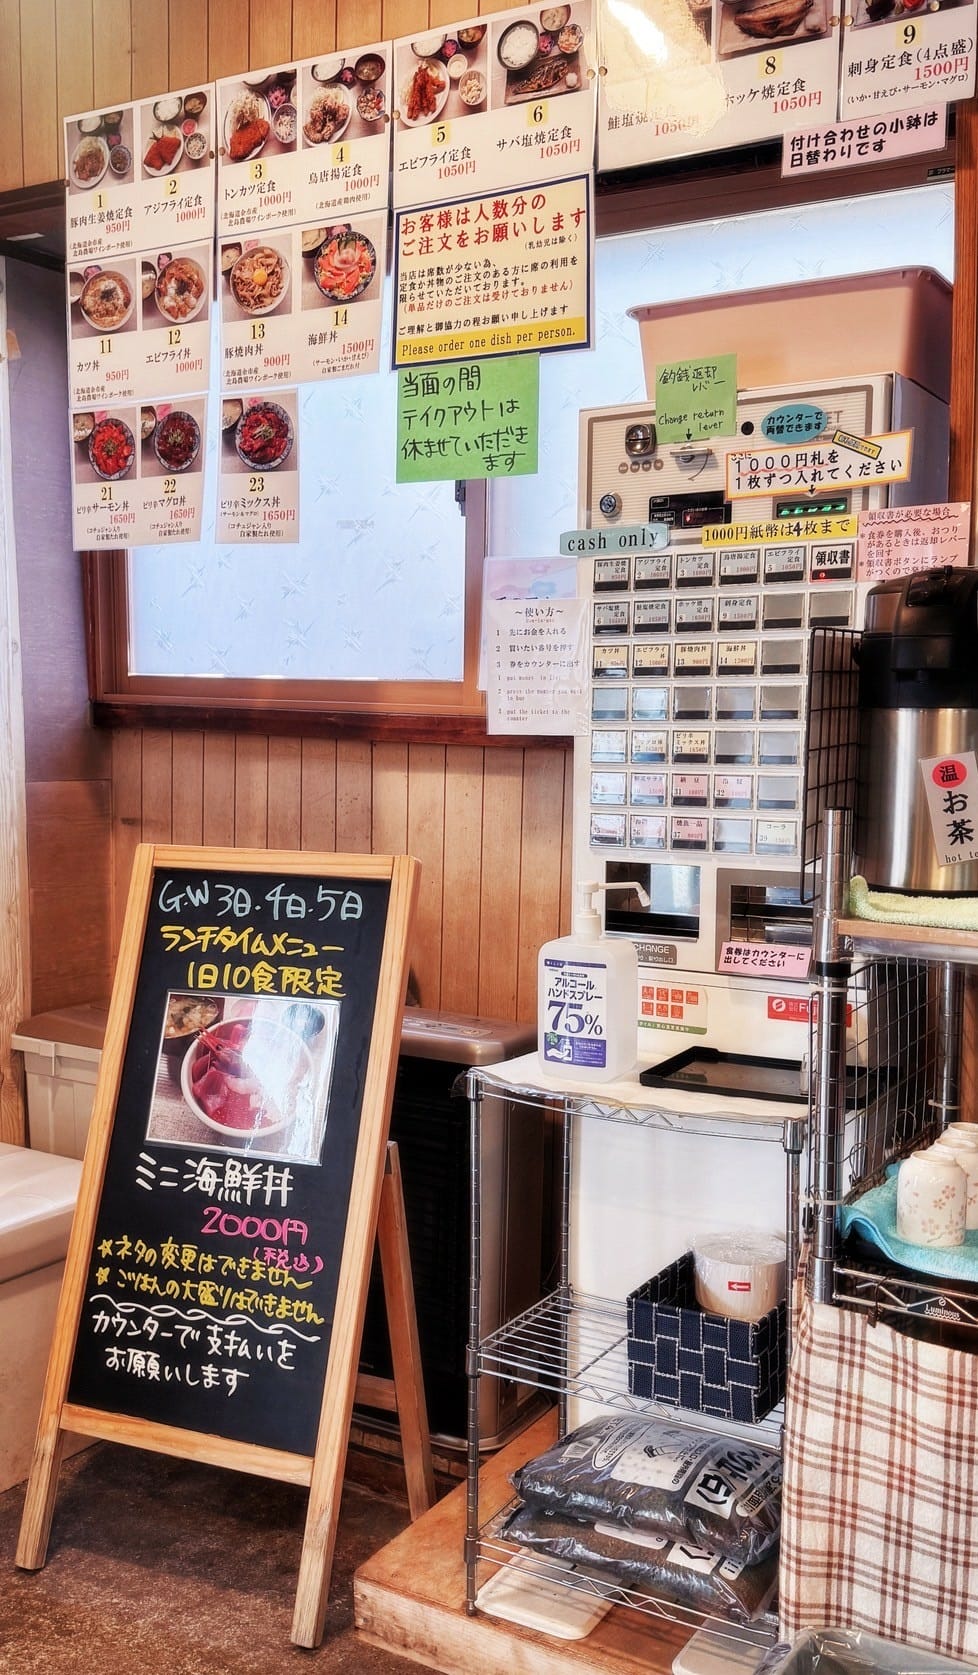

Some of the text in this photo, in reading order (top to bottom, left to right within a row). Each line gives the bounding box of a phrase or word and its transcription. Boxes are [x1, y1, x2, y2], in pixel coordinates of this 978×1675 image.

[903, 25, 915, 44] 9
[764, 56, 776, 75] 8
[847, 37, 974, 77] 刺身定食(4点盛)
[914, 57, 969, 81] 1500円
[724, 78, 806, 109] ホッケ焼定食
[772, 91, 822, 114] 1050円
[532, 105, 544, 123] 6
[436, 126, 446, 143] 5
[496, 126, 573, 151] サバ塩焼定食
[790, 111, 939, 152] 付け合わせの小鉢は
[335, 147, 345, 162] 4
[539, 139, 582, 160] 1050円
[789, 139, 887, 169] 日替わりです
[398, 146, 472, 173] エビフライ定食
[254, 163, 263, 179] 3
[437, 160, 477, 180] 1050円
[168, 180, 177, 195] 2
[224, 180, 276, 200] トンカツ定食
[344, 174, 380, 192] 1000円
[95, 194, 104, 208] 1
[143, 194, 203, 216] アジフライ定食
[258, 191, 292, 208] 1000円
[70, 206, 133, 228] 豚肉生姜焼定食
[175, 206, 206, 223] 1000円
[401, 193, 547, 236] お客様は人数分の
[105, 220, 130, 234] 950円
[402, 208, 587, 258] ご注文をお願いします
[524, 233, 578, 251] (乳幼児は除く)
[399, 259, 498, 282] 当店は席数が少ない為、
[399, 256, 579, 293] 定食か丼物のご注文のある方に席の利用を
[399, 279, 526, 304] 限らせていただいております。
[402, 279, 575, 315] (単品だけのご注文は受けておりません)
[333, 309, 348, 326] 14
[398, 305, 569, 336] ご理解と御協力の程お願い申し上げます
[168, 329, 181, 345] 12
[251, 323, 265, 340] 13
[308, 331, 338, 346] 海鮮丼
[100, 339, 112, 354] 11
[341, 339, 375, 355] 1500円
[402, 325, 576, 357] Please order one dish per person.
[145, 347, 192, 364] エビフライ丼
[224, 343, 264, 359] 豚焼肉丼
[76, 359, 100, 373] カツ丼
[175, 358, 203, 374] 1000円
[263, 353, 291, 367] 900円
[105, 369, 130, 382] 950円
[402, 365, 481, 398] 当面の間
[691, 379, 726, 392] レバー
[402, 399, 520, 430] テイクアウトは
[658, 408, 725, 426] Change return
[766, 410, 824, 425] カウンターで
[698, 420, 724, 432] lever
[765, 421, 822, 435] 両替できます
[400, 426, 529, 461] 休ませていただき
[482, 451, 526, 472] ます
[730, 451, 753, 461] ここに
[735, 450, 839, 473] 1000円札を
[735, 460, 903, 490] 1枚ずつ入れてください
[163, 479, 176, 494] 22
[249, 476, 265, 492] 23
[101, 487, 112, 501] 21
[143, 495, 187, 510] ピリ辛マグロ丼
[220, 495, 281, 509] ピリ辛ミックス丼
[76, 500, 130, 515] ピリ辛サーモン丼
[169, 507, 195, 520] 1650円
[262, 509, 296, 521] 1650円
[868, 506, 951, 521] 領収書が必要な場合
[109, 512, 136, 525] 1650円
[704, 518, 851, 543] 1000円紙幣は4枚まで
[567, 528, 658, 552] cash only
[867, 536, 967, 548] があるときは返却レバー
[680, 556, 703, 564] トンカツ
[815, 549, 851, 566] 領収書
[867, 549, 893, 558] を回す
[940, 764, 959, 783] 温
[943, 791, 974, 846] お茶
[945, 853, 962, 864] hot
[160, 925, 345, 957] ランチタイムメニュー
[634, 943, 670, 954] CHANGE
[723, 956, 785, 968] 出してください
[187, 960, 347, 997] 1日10食限定
[554, 977, 594, 990] アルコール
[548, 987, 603, 1001] ハンドスプレー
[548, 1000, 603, 1036] 75%
[135, 1151, 295, 1207] ミニ海鮮丼
[200, 1206, 309, 1246] 2000円
[252, 1246, 325, 1275] (税込)
[924, 1304, 960, 1318] Luminous
[105, 1346, 250, 1397] お願いします
